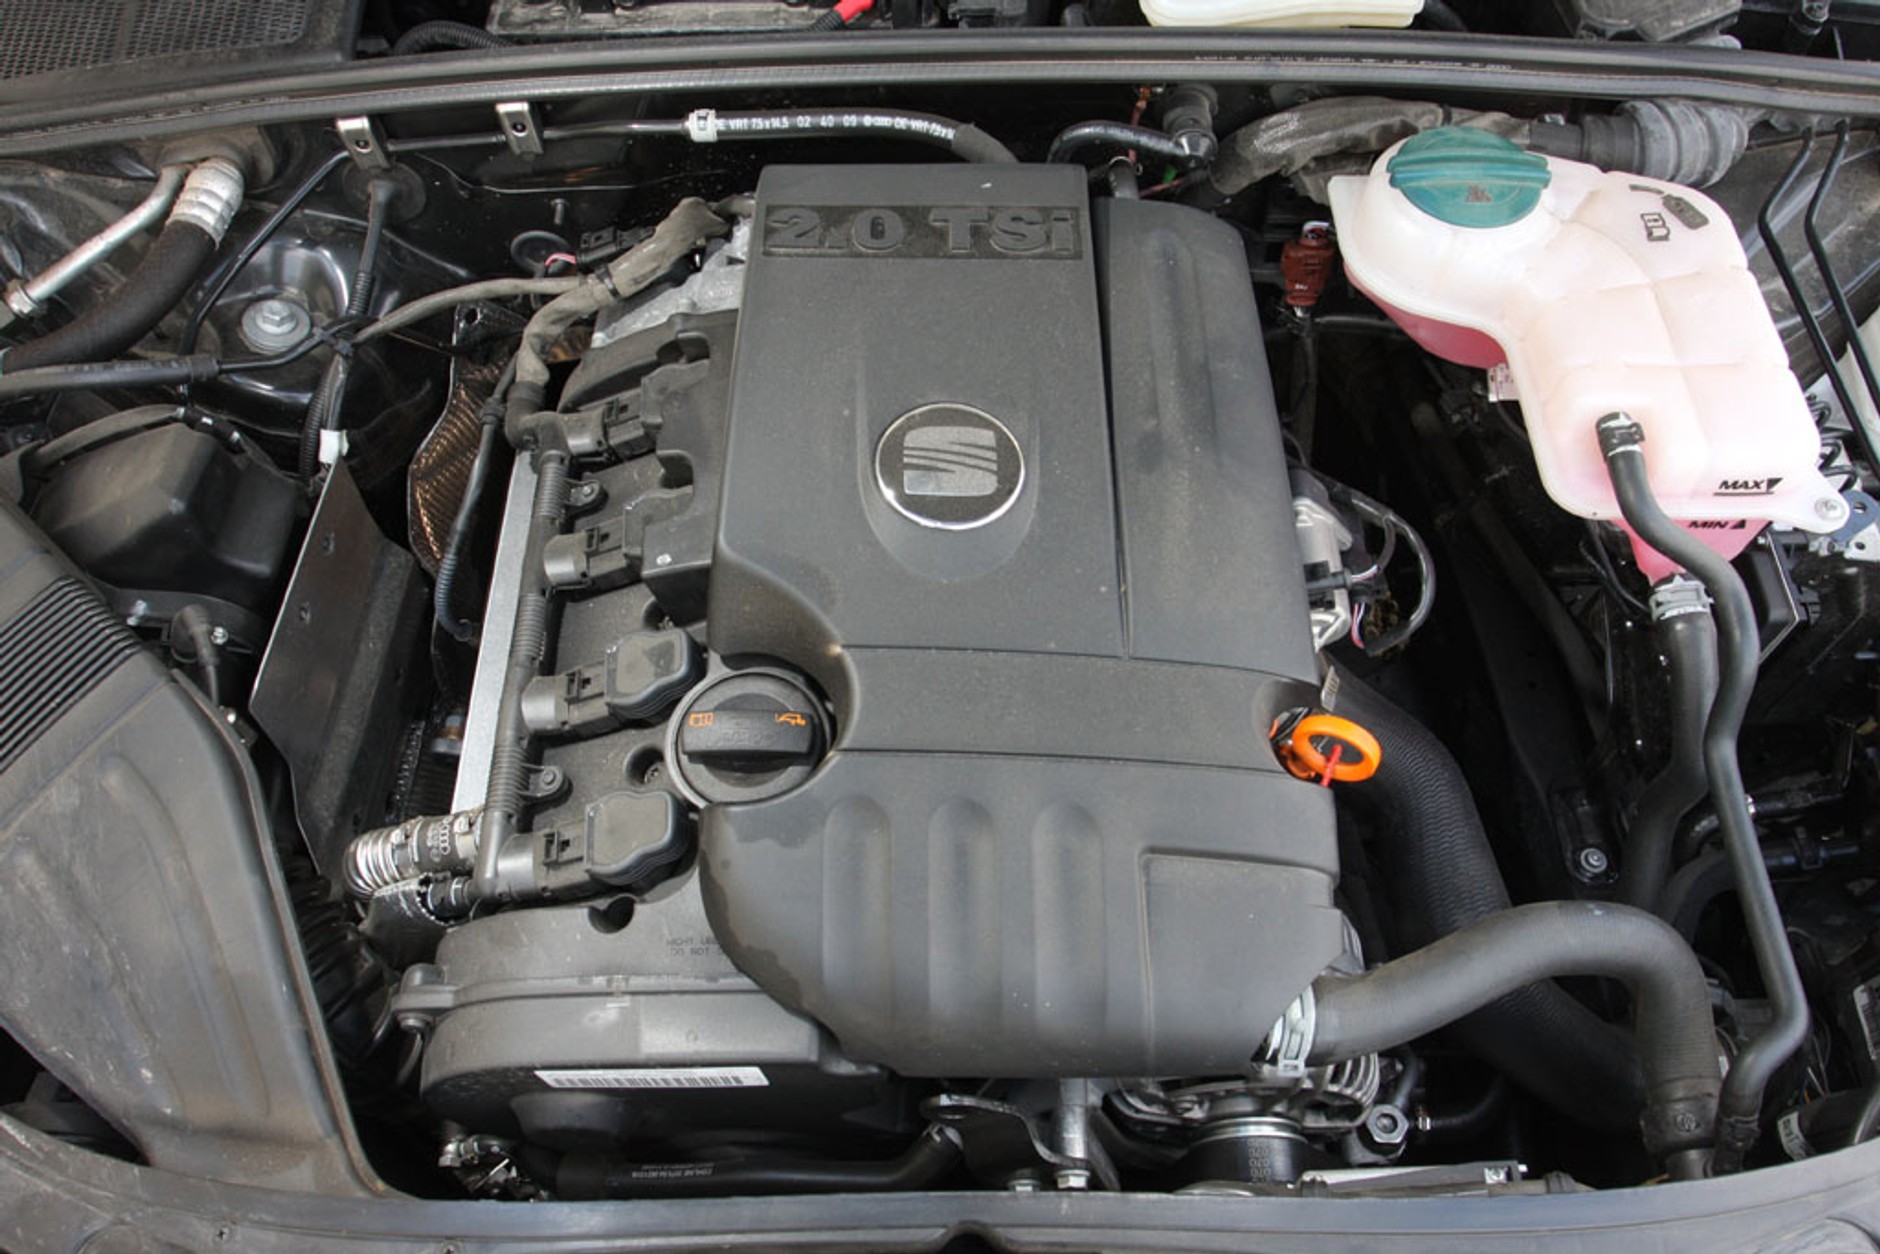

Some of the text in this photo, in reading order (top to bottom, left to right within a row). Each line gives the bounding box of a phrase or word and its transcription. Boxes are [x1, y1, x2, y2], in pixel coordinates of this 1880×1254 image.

[766, 207, 904, 252] 2.0
[1718, 480, 1765, 490] MAX
[1687, 520, 1729, 529] MIN
